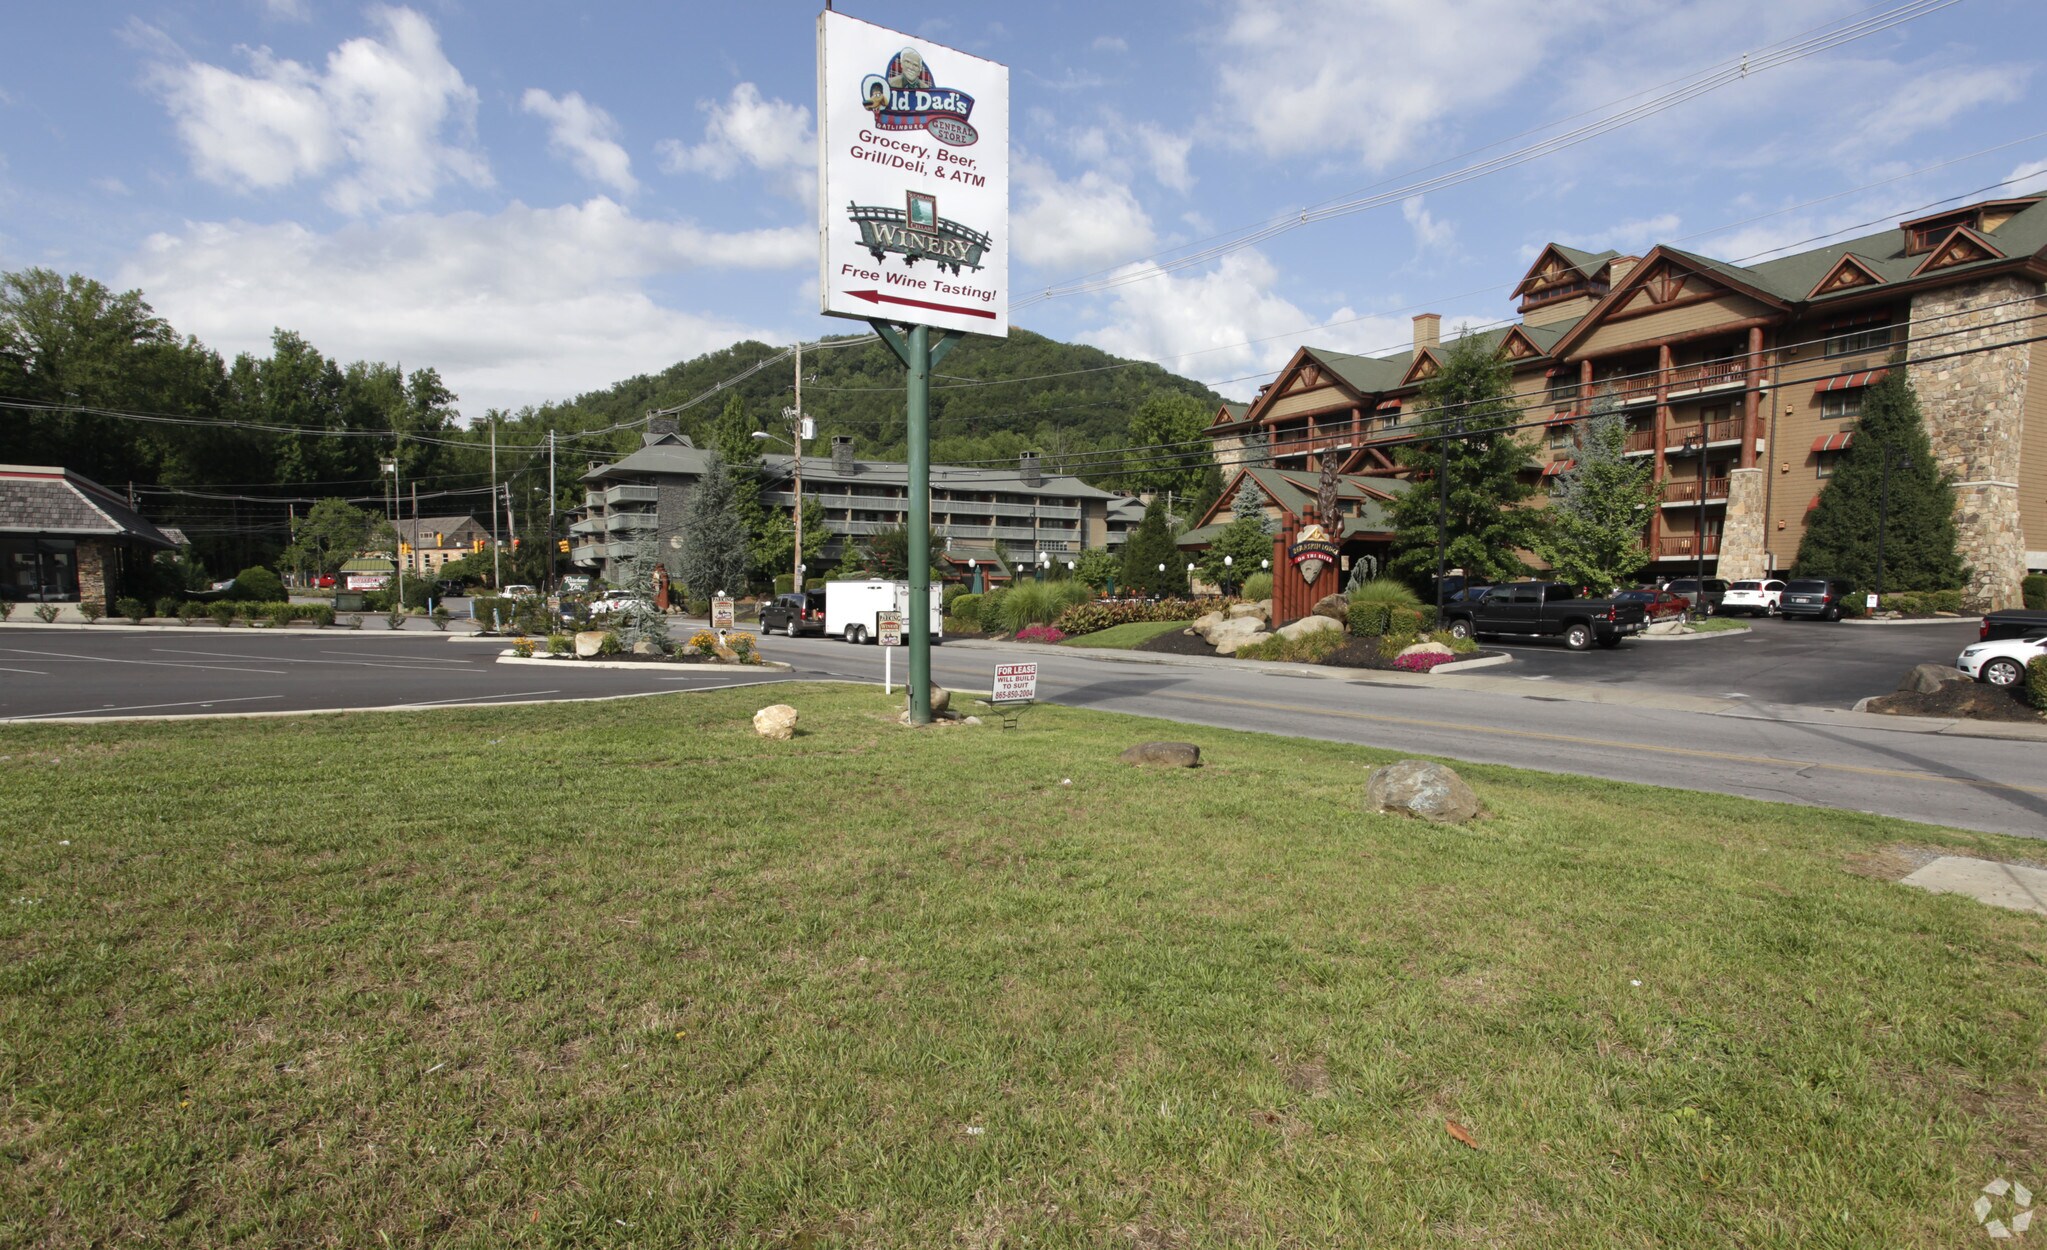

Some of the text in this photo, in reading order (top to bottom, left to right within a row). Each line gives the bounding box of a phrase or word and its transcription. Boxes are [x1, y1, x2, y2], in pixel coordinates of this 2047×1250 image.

[862, 75, 967, 115] Old Dad's
[932, 120, 973, 137] GENERAL
[938, 130, 967, 143] STORE
[858, 129, 977, 170] Grocery, Beer,
[850, 145, 986, 188] Grill/Deli, & ATM
[868, 220, 974, 262] WINERY
[841, 263, 997, 302] Free Wine Tasting!
[1318, 554, 1333, 562] RIVER
[998, 666, 1035, 675] FOR LEASE
[995, 690, 1033, 699] 865-850-2004
